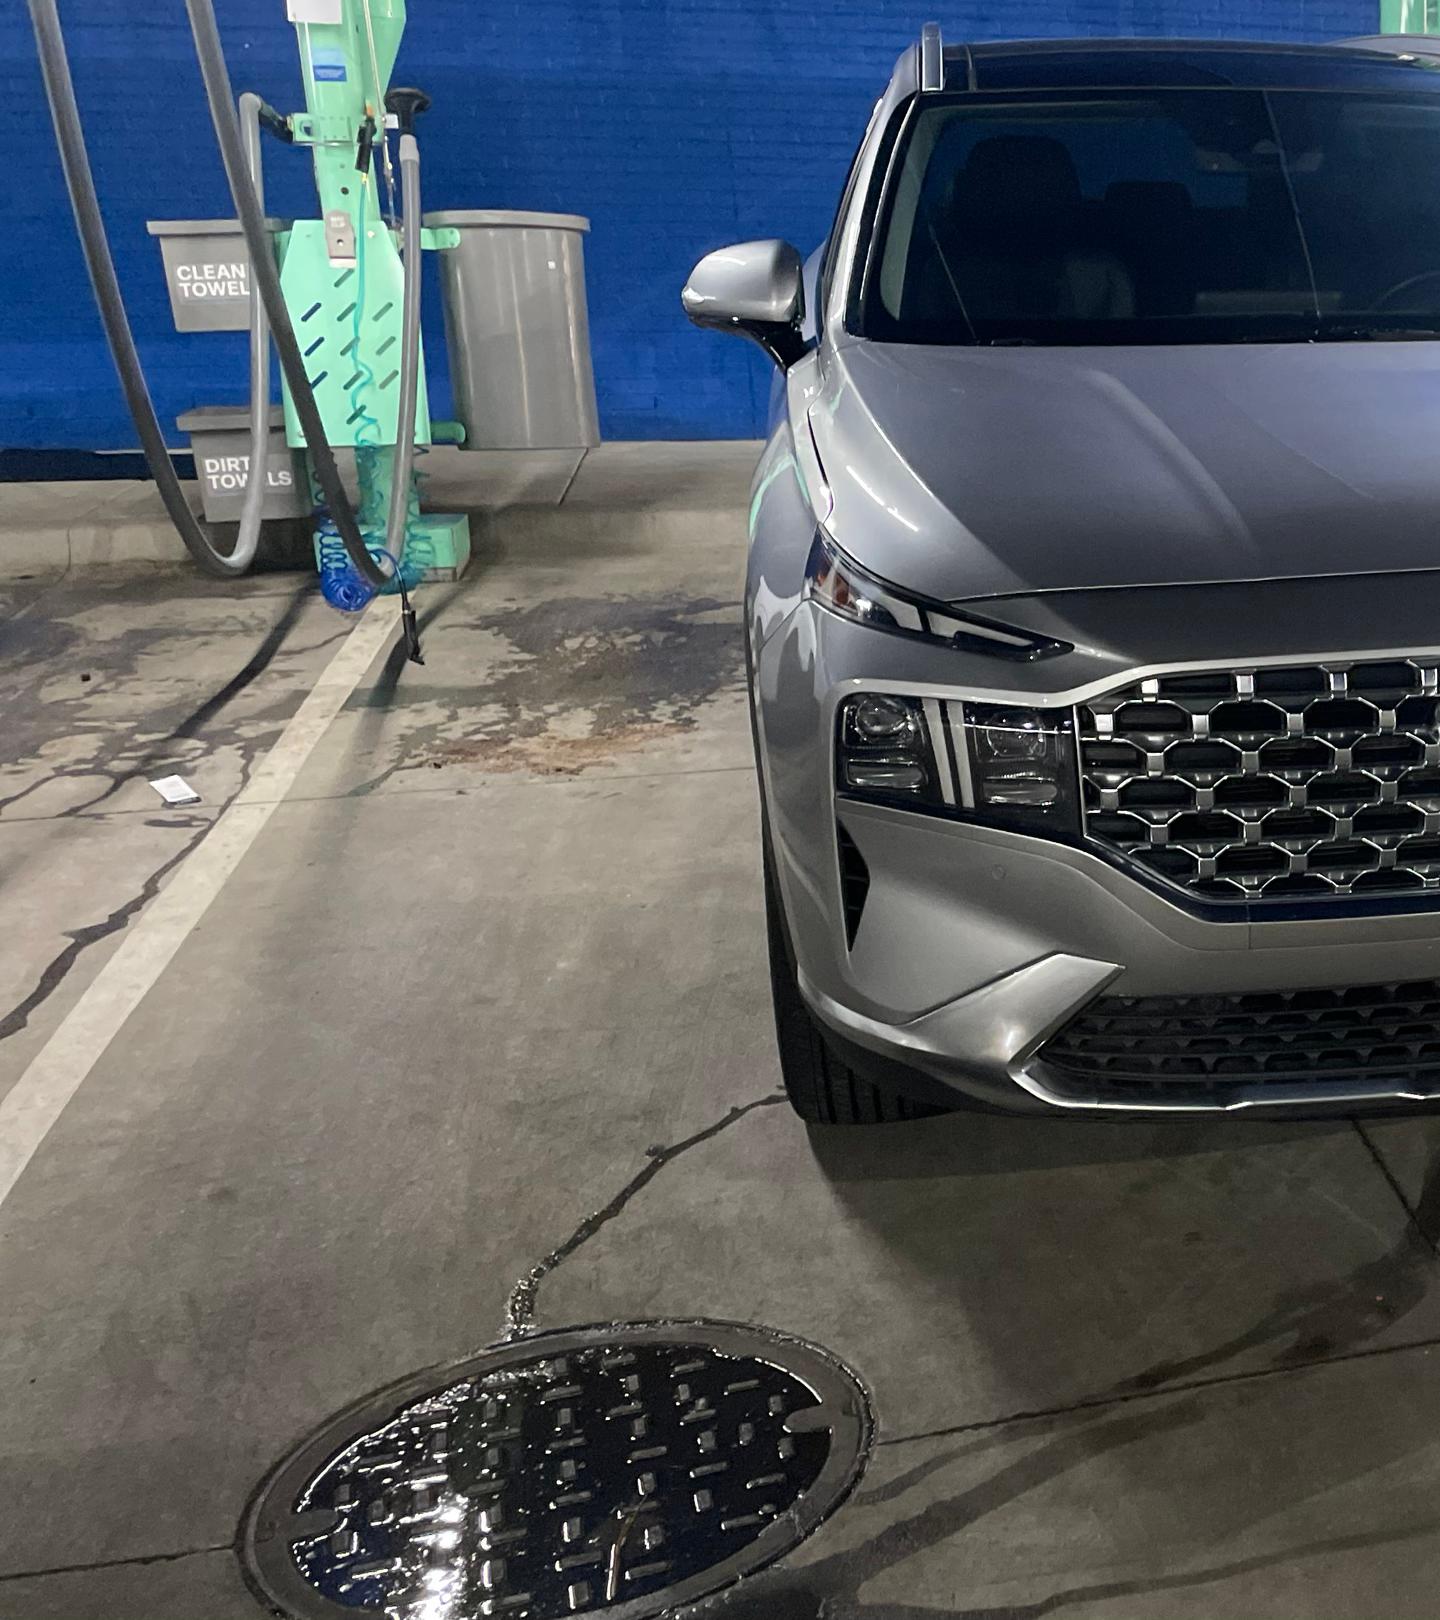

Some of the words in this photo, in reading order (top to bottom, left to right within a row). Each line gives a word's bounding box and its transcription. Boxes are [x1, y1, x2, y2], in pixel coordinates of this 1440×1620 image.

[177, 264, 246, 281] CLEAN
[179, 281, 250, 298] TOWEL
[205, 456, 250, 473] DIRT
